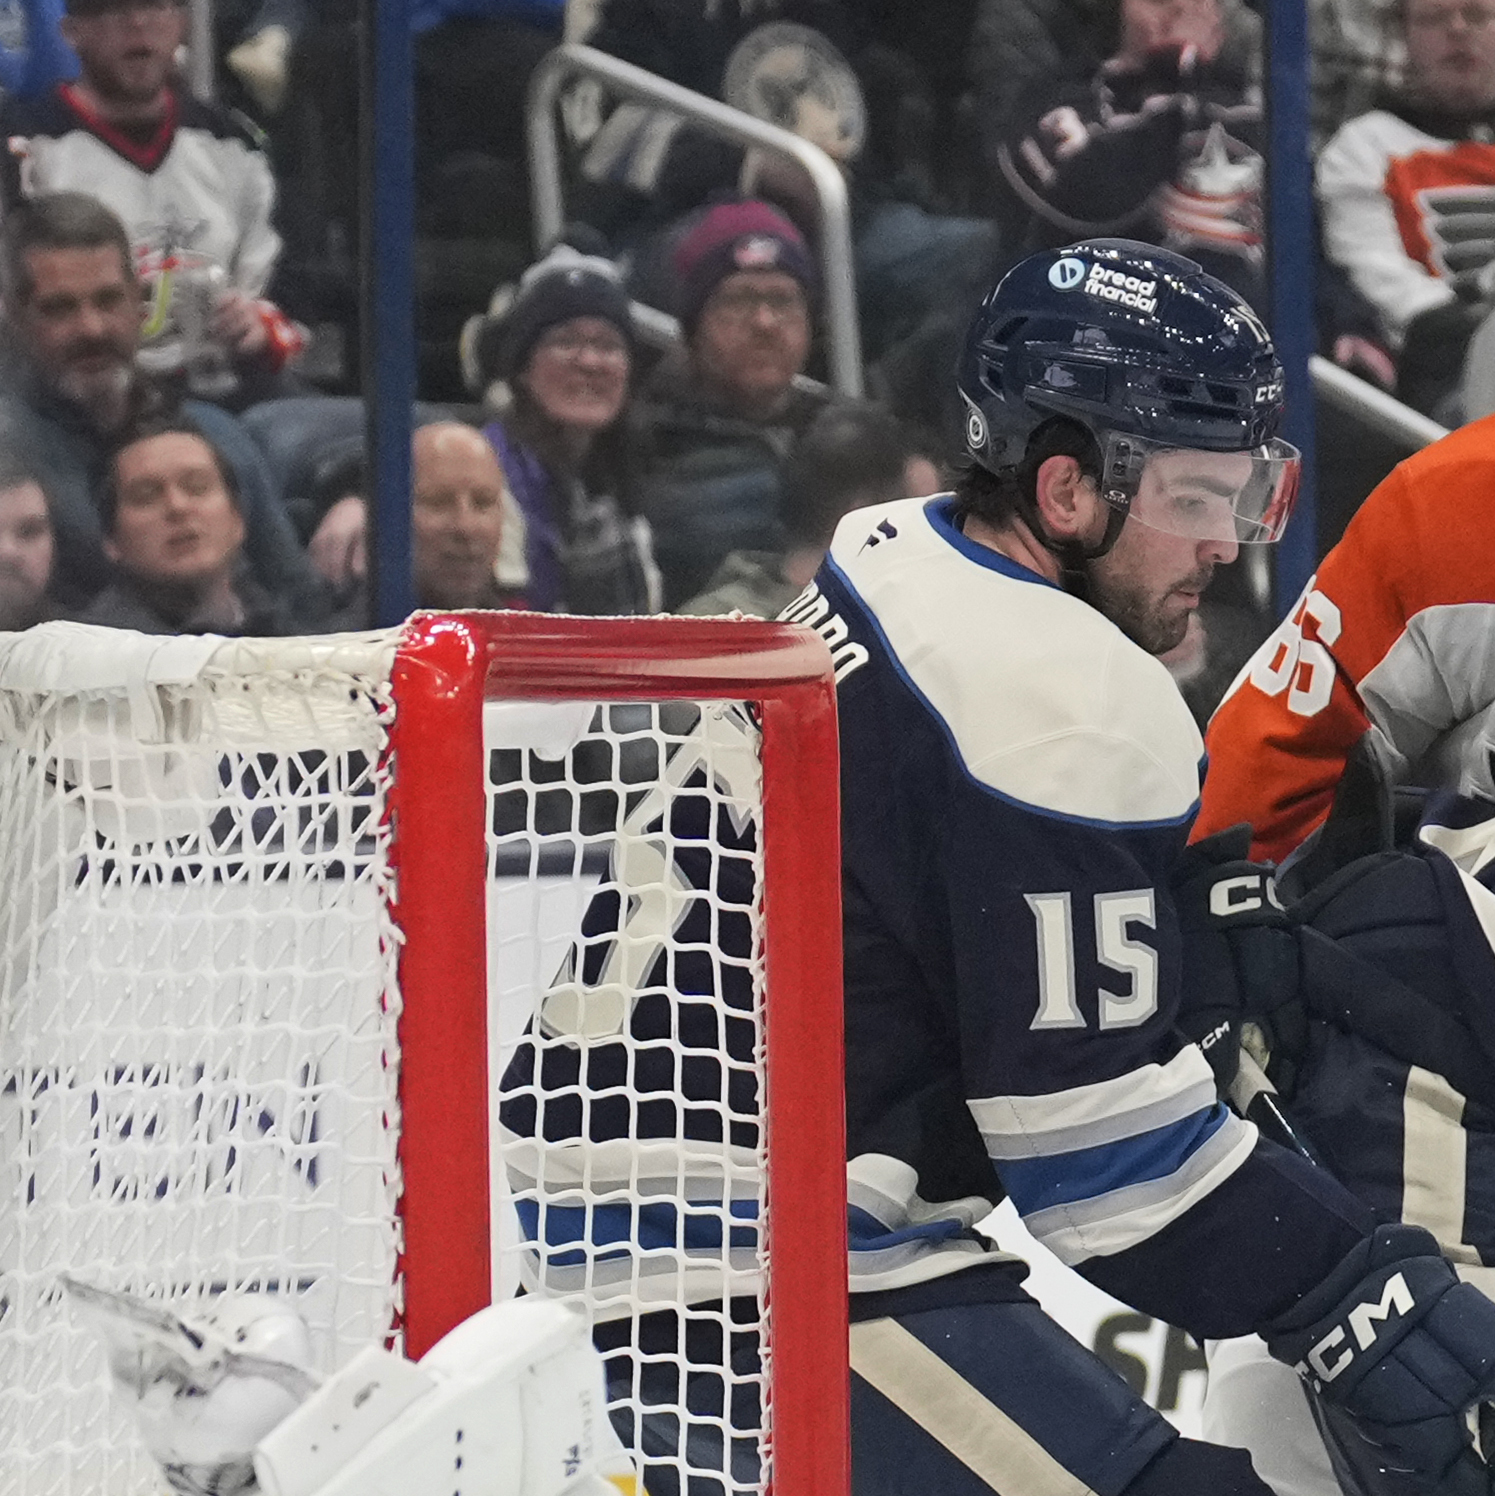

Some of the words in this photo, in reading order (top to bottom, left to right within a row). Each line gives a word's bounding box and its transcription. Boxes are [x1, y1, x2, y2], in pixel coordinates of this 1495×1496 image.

[1084, 279, 1158, 313] financial
[1089, 263, 1157, 297] bread
[1255, 384, 1284, 403] CC
[1250, 589, 1343, 717] 86
[1023, 888, 1158, 1030] 15
[1198, 1021, 1230, 1050] CM
